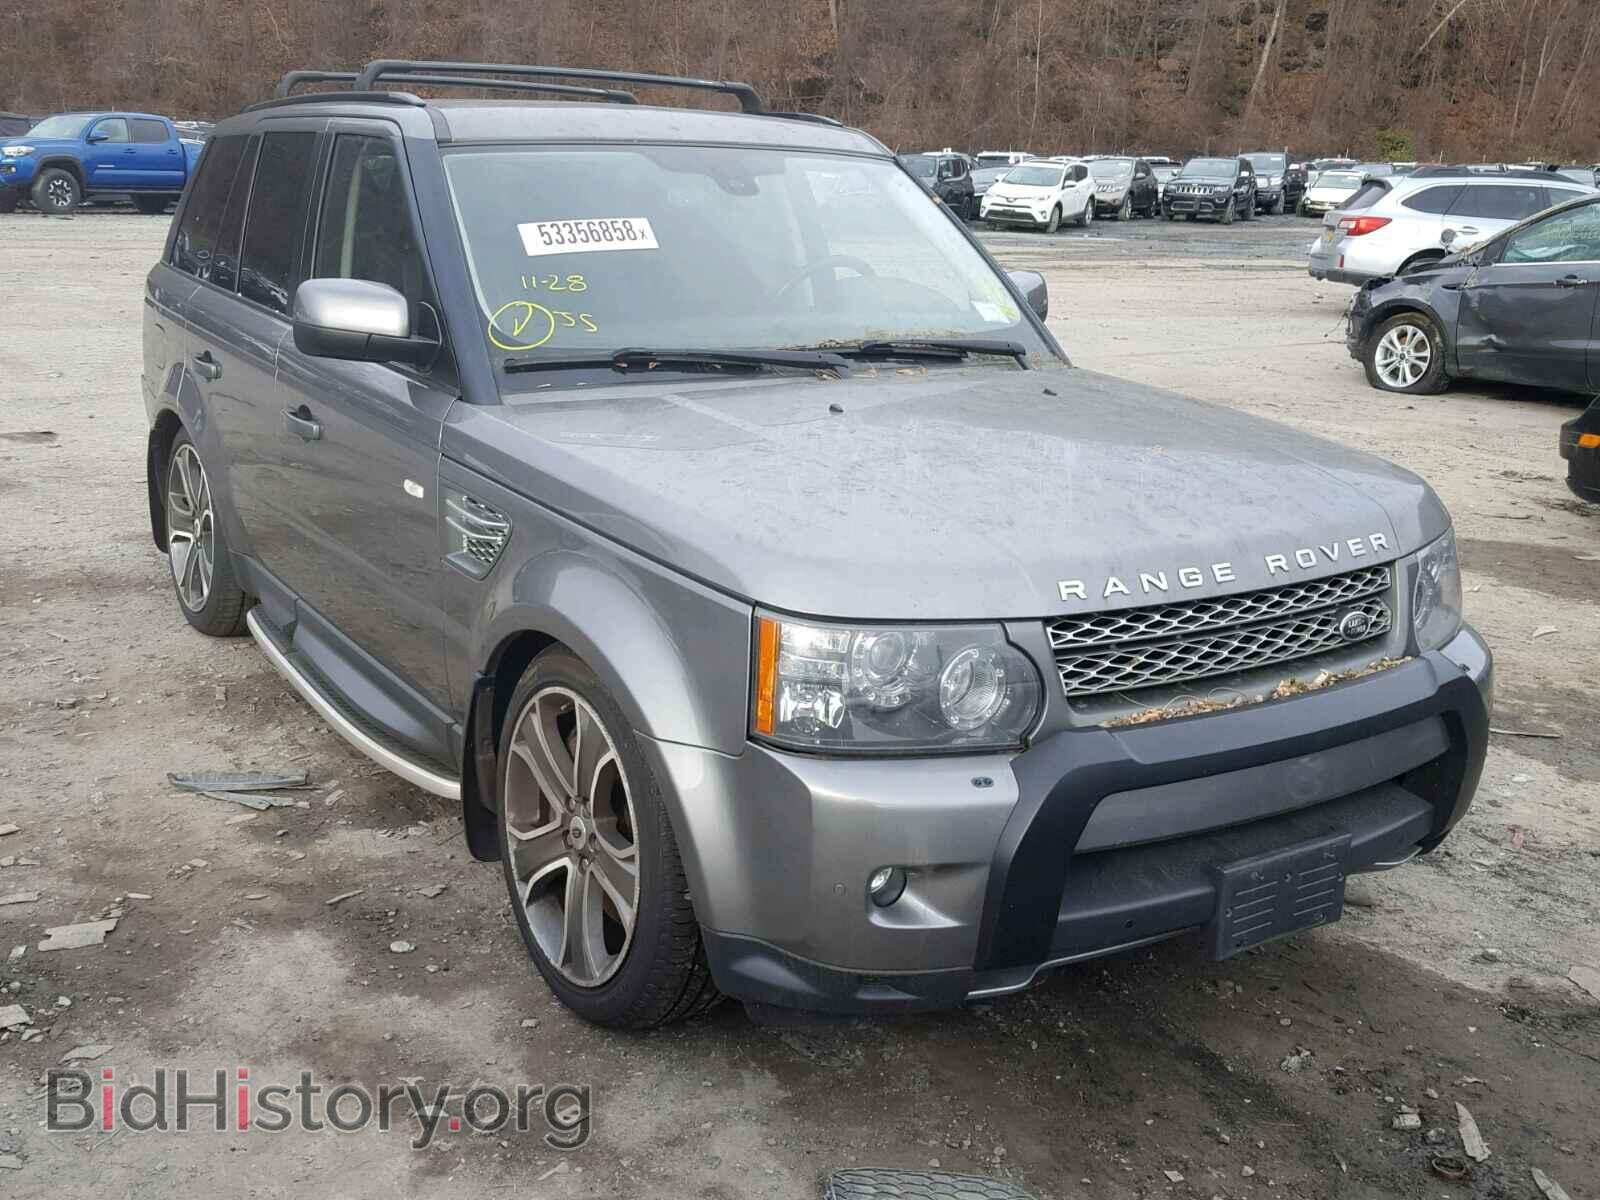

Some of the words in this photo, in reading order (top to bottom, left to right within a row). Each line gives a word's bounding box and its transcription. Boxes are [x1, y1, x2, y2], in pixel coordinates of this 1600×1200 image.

[521, 274, 588, 291] 11-28
[1058, 562, 1236, 601] RANGE
[1264, 532, 1389, 574] ROVER
